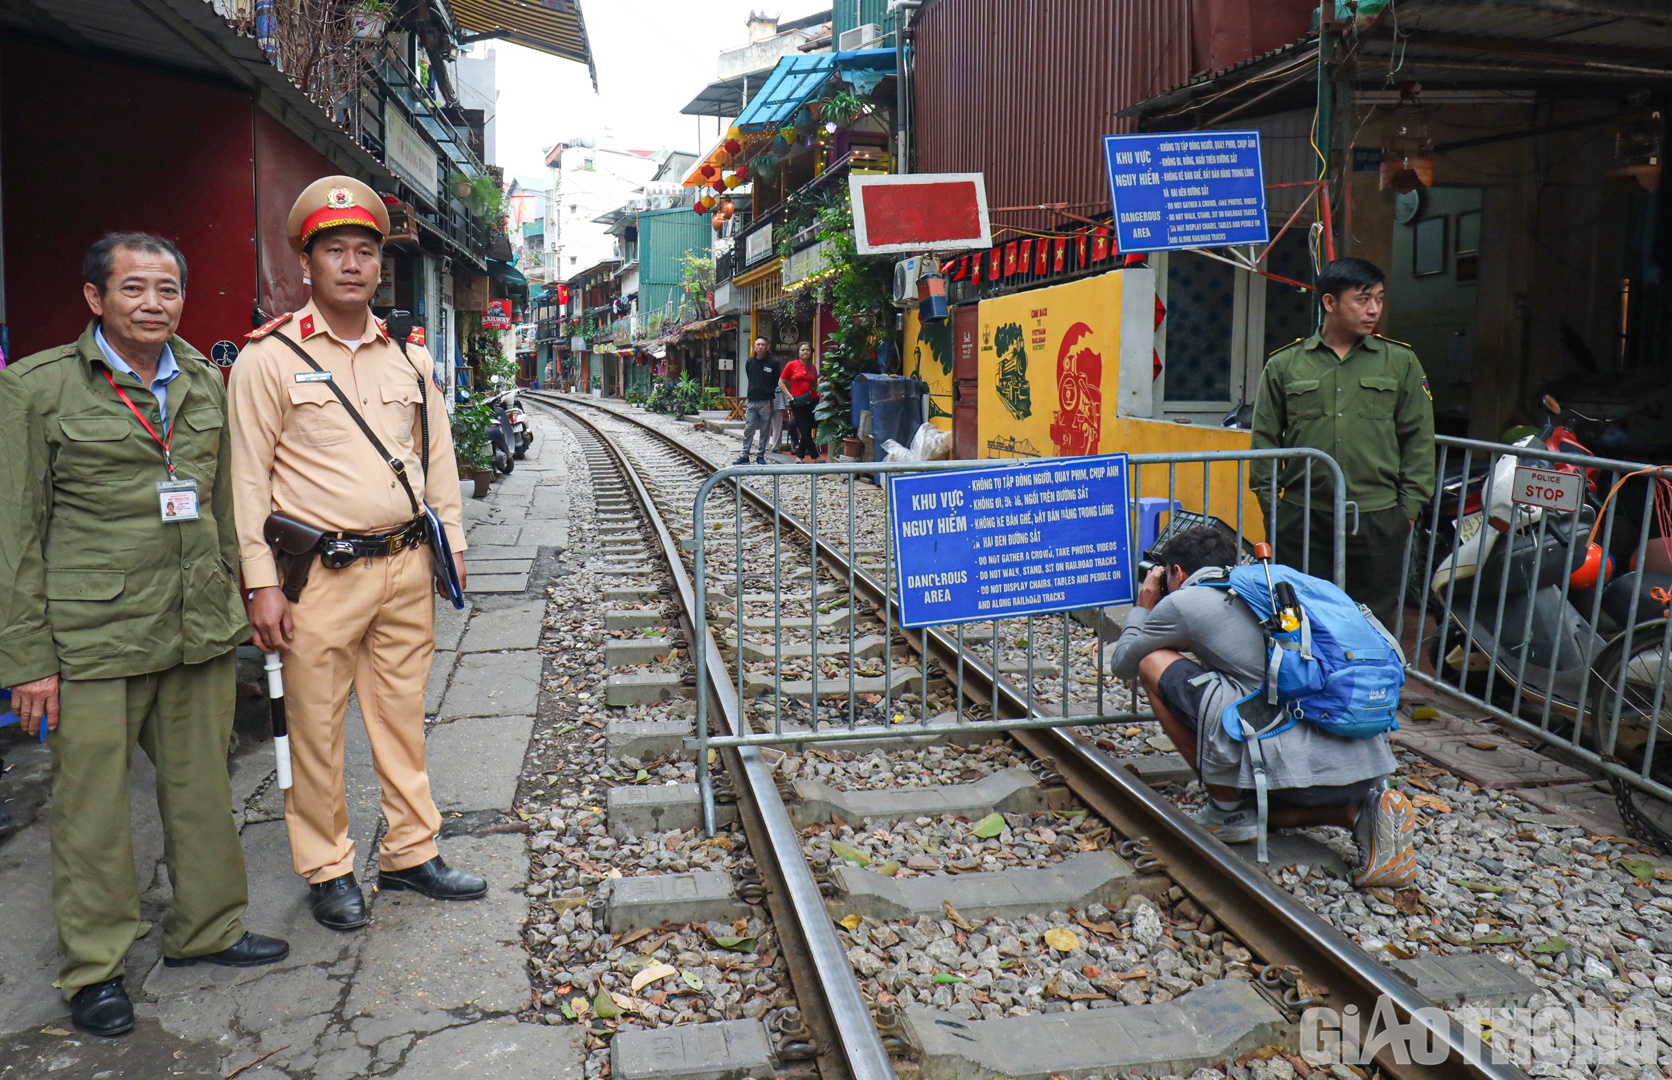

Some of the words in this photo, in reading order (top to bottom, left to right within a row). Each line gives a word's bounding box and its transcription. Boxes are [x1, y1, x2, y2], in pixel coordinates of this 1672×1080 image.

[1160, 141, 1174, 152] KHÔNG
[1215, 141, 1224, 150] QUAY
[1237, 139, 1247, 150] CHỤP
[1116, 152, 1132, 164] KHU
[1135, 150, 1151, 166] VỰC
[1162, 156, 1176, 166] KHÔNG
[1206, 154, 1216, 164] TRÊN
[1115, 174, 1136, 186] NGUY
[1139, 168, 1160, 185] HIỂM
[1164, 171, 1178, 181] KHÔNG
[1231, 169, 1244, 178] TRONG
[1121, 211, 1160, 223] DANGEROUS
[1133, 228, 1151, 238] AREA
[972, 477, 992, 491] KHÔNG
[994, 478, 1001, 491] TỤ
[1003, 474, 1014, 490] TẬP
[1016, 473, 1032, 486] ĐÔNG
[1055, 470, 1069, 483] QUAY
[1071, 468, 1088, 481] PHIM,
[1090, 467, 1105, 481] CHỤP
[1107, 462, 1118, 477] ẢNH
[1532, 473, 1561, 483] POLICE
[912, 493, 936, 511] KHU
[940, 489, 964, 510] VỰC
[974, 497, 994, 510] KHÔNG
[1040, 490, 1054, 503] TRÊN
[1056, 487, 1076, 501] ĐƯỜNG
[1078, 484, 1088, 499] SẮT
[1526, 485, 1564, 501] STOP
[902, 519, 934, 538] NGUY
[938, 510, 967, 534] HIỂM
[975, 516, 995, 529] KHÔNG
[1020, 509, 1033, 525] GHẾ,
[1078, 507, 1097, 518] TRONG
[1099, 502, 1114, 516] LÒNG
[983, 536, 993, 548] HAI
[1008, 531, 1028, 544] ĐƯỜNG
[1030, 528, 1041, 542] SẮT
[978, 556, 987, 565] DO
[988, 554, 1000, 564] NOT
[1002, 552, 1024, 563] GATHER
[1026, 552, 1029, 560] A
[1056, 547, 1070, 556] TAKE
[1072, 545, 1095, 555] PHOTOS,
[1096, 542, 1117, 552] VIDEOS
[980, 570, 988, 580] DO
[990, 569, 1001, 578] NOT
[1002, 567, 1022, 577] WALK,
[1023, 565, 1044, 575] STAND,
[1045, 564, 1054, 572] SIT
[1056, 563, 1064, 571] ON
[1066, 559, 1093, 570] RAILROAD
[1094, 557, 1116, 567] TRACKS
[981, 585, 989, 594] DO
[990, 584, 1002, 593] NOT
[1004, 581, 1028, 592] DISPLAY
[1054, 576, 1075, 586] TABLES
[1076, 574, 1088, 584] AND
[1090, 572, 1111, 582] PEDDLE
[1113, 571, 1121, 579] ON
[924, 589, 951, 604] AREA
[978, 600, 990, 610] AND
[992, 597, 1011, 608] ALONG
[1013, 594, 1041, 606] RAILROAD
[1043, 592, 1065, 602] TRACKS
[1224, 813, 1245, 825] HOKA
